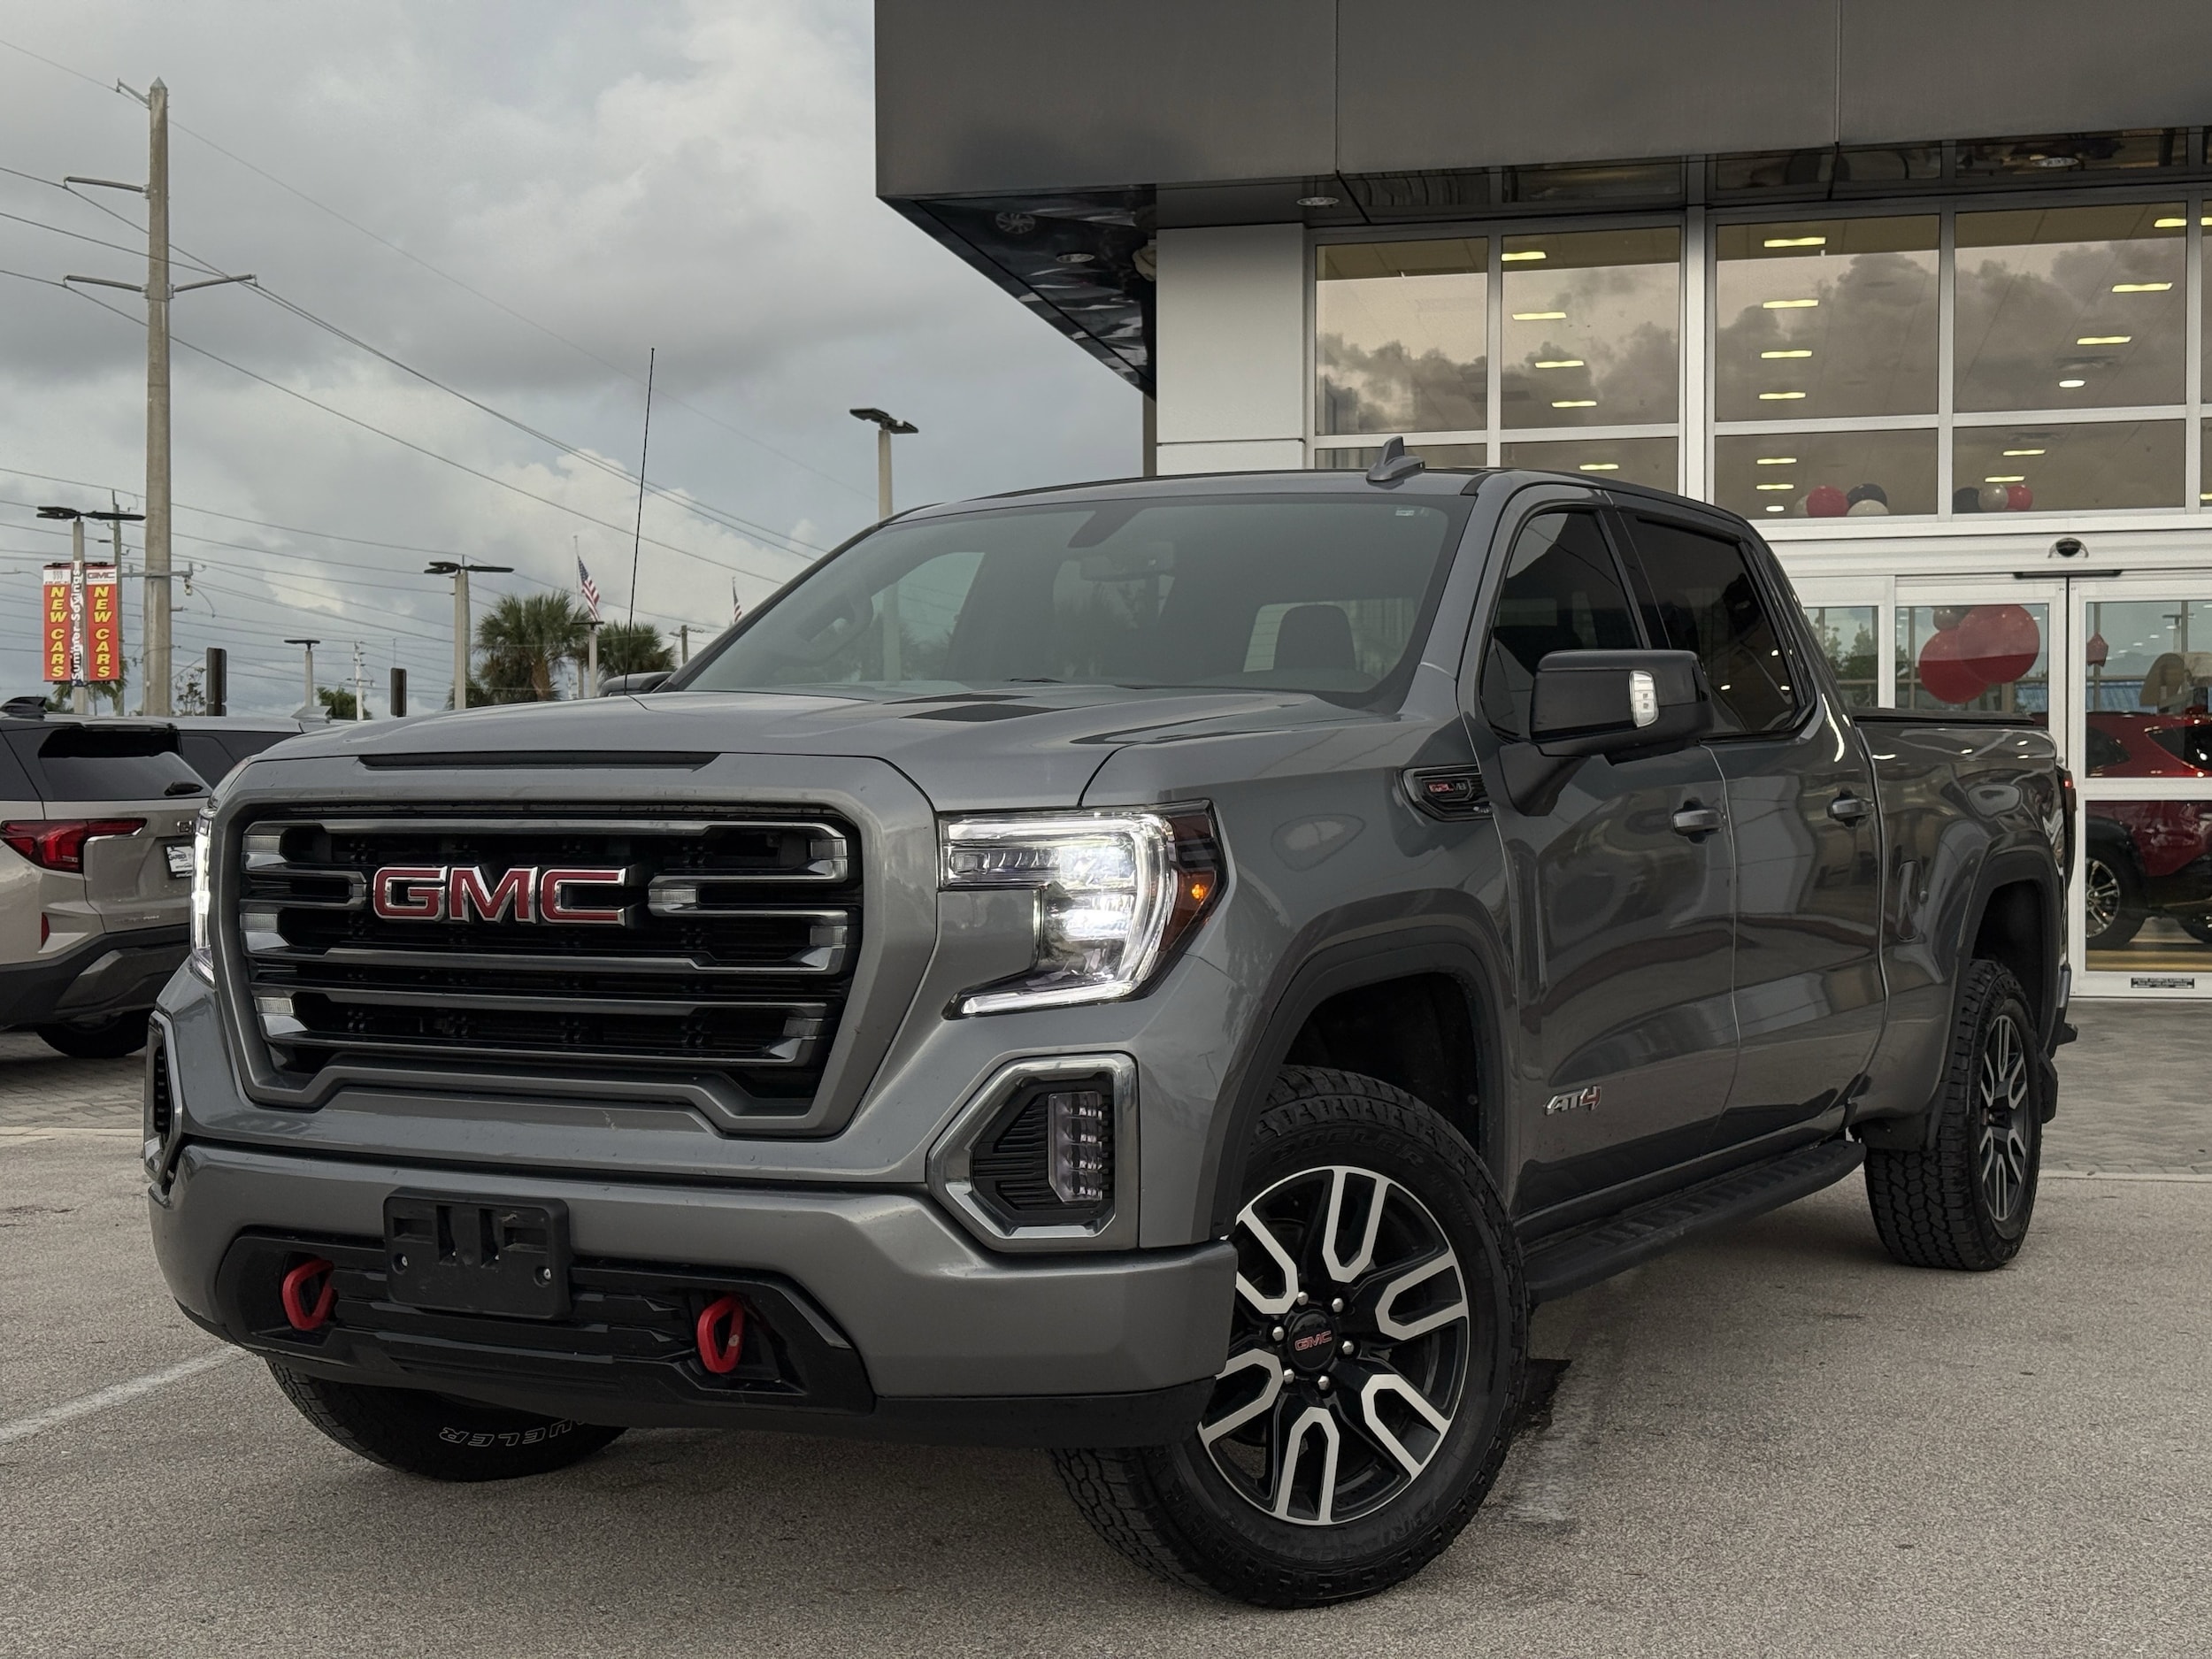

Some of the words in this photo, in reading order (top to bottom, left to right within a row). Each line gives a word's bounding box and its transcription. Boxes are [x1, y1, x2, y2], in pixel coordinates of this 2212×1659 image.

[50, 587, 67, 623] NEW
[94, 587, 111, 623] NEW
[50, 629, 65, 677] CARS
[96, 629, 111, 677] CARS
[373, 865, 626, 927] GMC
[1545, 1085, 1601, 1116] AT4
[1294, 1330, 1333, 1351] GMC
[439, 1418, 585, 1448] UELER
